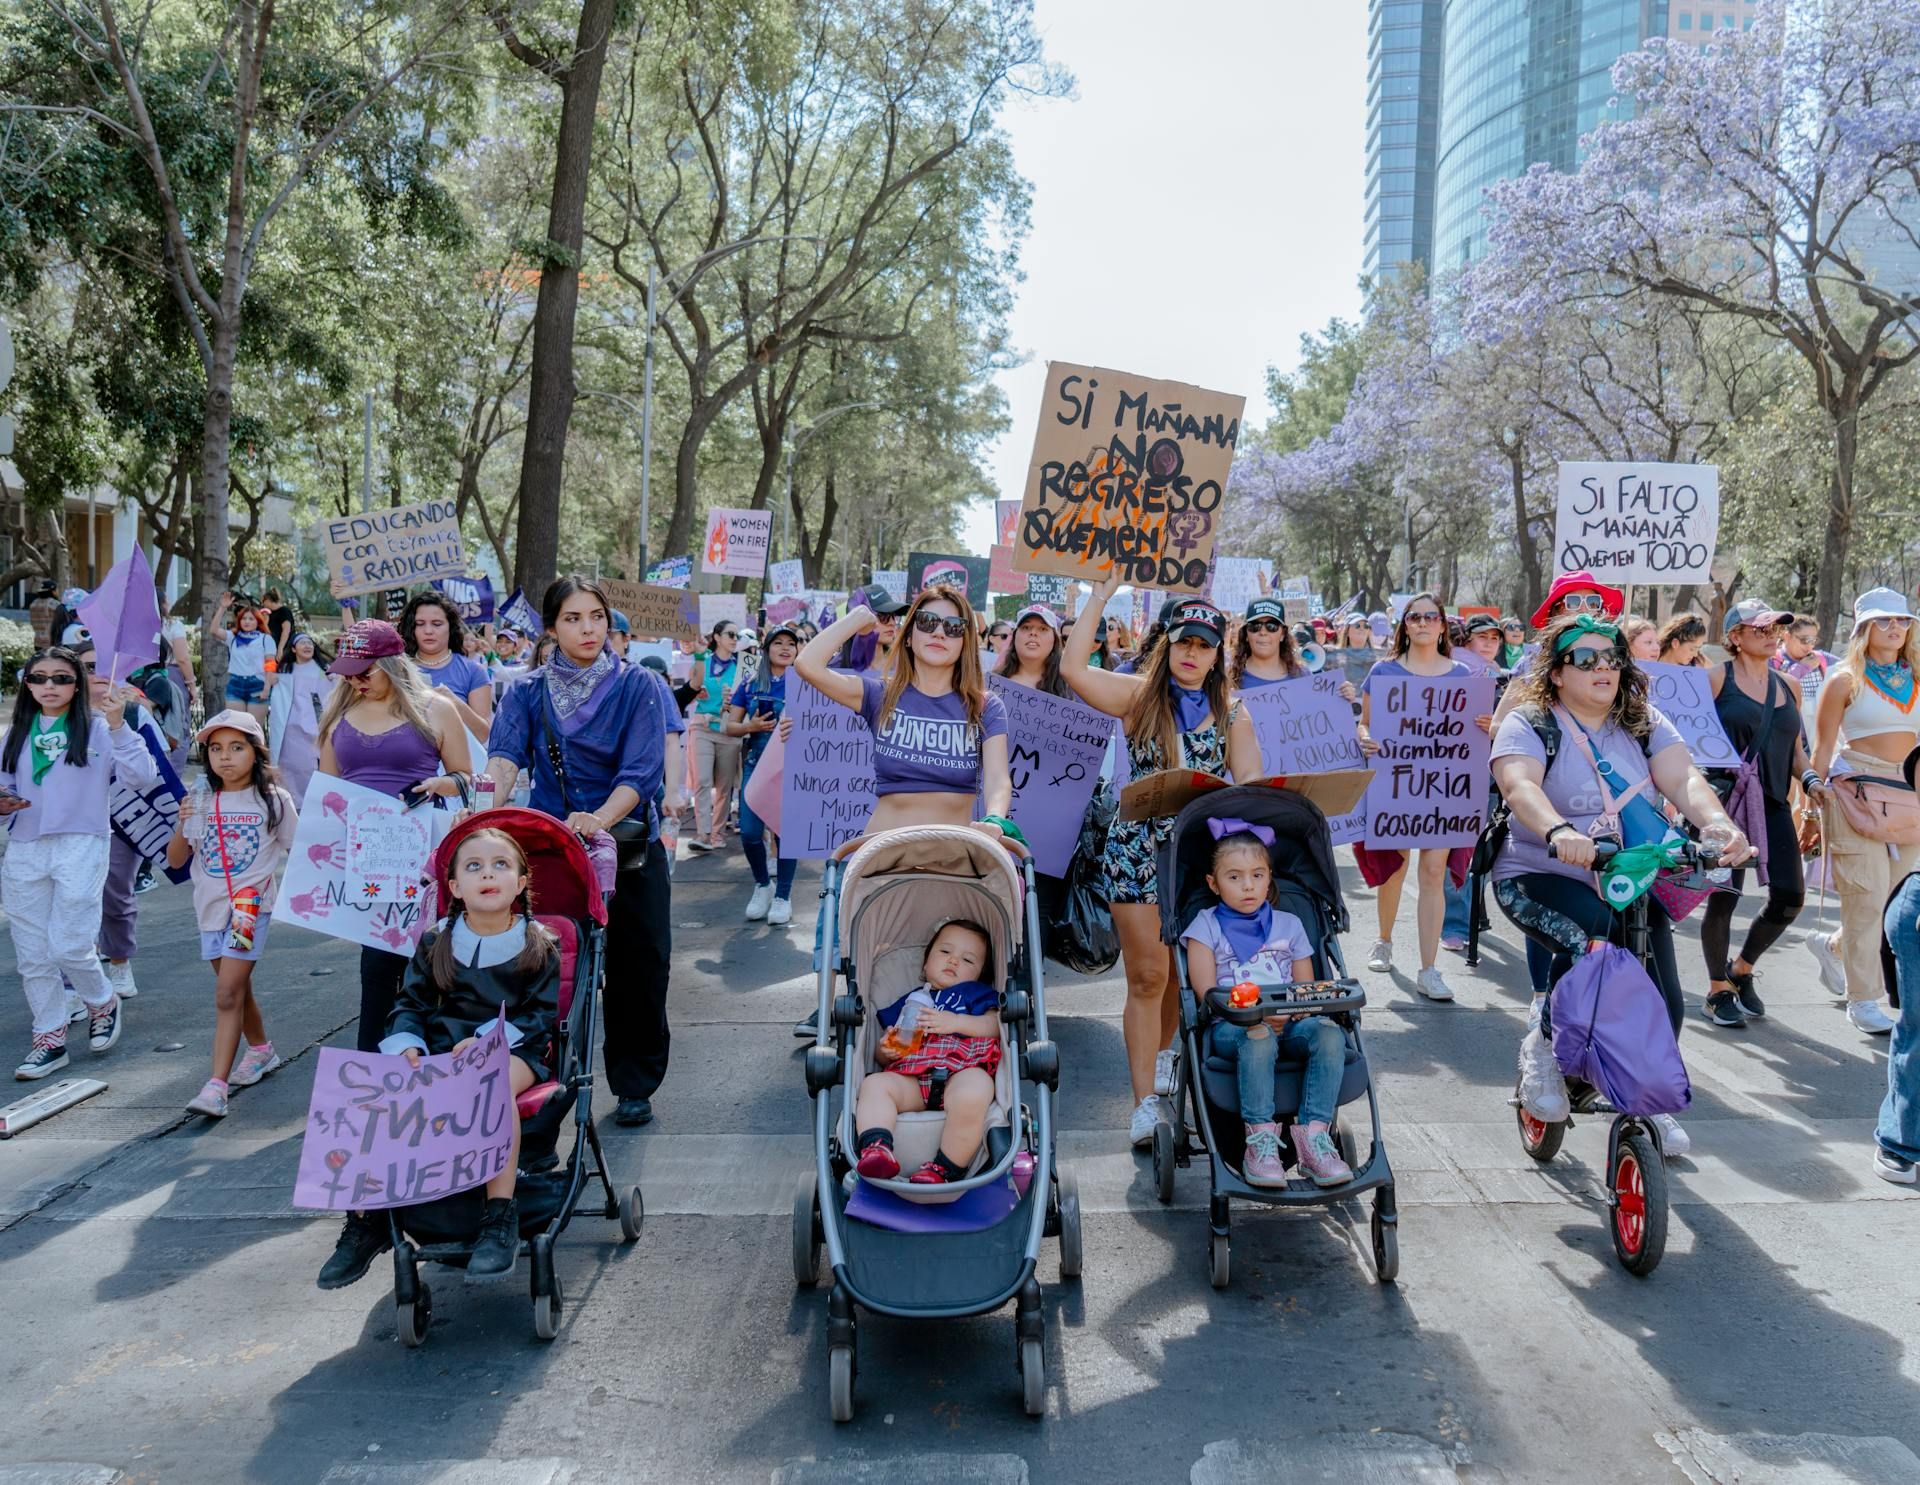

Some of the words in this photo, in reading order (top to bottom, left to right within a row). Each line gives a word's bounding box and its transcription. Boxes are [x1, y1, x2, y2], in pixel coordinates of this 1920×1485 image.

[1106, 432, 1184, 481] NO
[1573, 477, 1605, 515] SI
[1618, 475, 1698, 517] FALTO
[329, 501, 457, 545] EDUCANDO
[730, 517, 769, 530] WOMEN
[1582, 515, 1686, 539] MAÑANA
[343, 543, 379, 561] con
[728, 534, 744, 545] ON
[747, 535, 767, 547] FIRE
[363, 545, 460, 581] RADICAL!!
[1561, 540, 1635, 571] QUEMEN
[1638, 540, 1708, 571] TODO
[1311, 676, 1336, 697] 8M
[1387, 681, 1407, 713] el
[1422, 686, 1467, 716] que
[1044, 698, 1057, 717] te
[881, 710, 976, 757] CHINGONA
[1008, 707, 1030, 726] las
[1033, 716, 1061, 735] que
[1062, 724, 1109, 750] Luchan
[1399, 714, 1464, 739] Miedo
[875, 743, 902, 760] MUJER
[1014, 729, 1041, 745] por
[1043, 737, 1066, 757] las
[1070, 747, 1100, 766] que
[1377, 738, 1470, 760] Siembre
[793, 772, 840, 795] Nunca
[230, 815, 260, 824] KART
